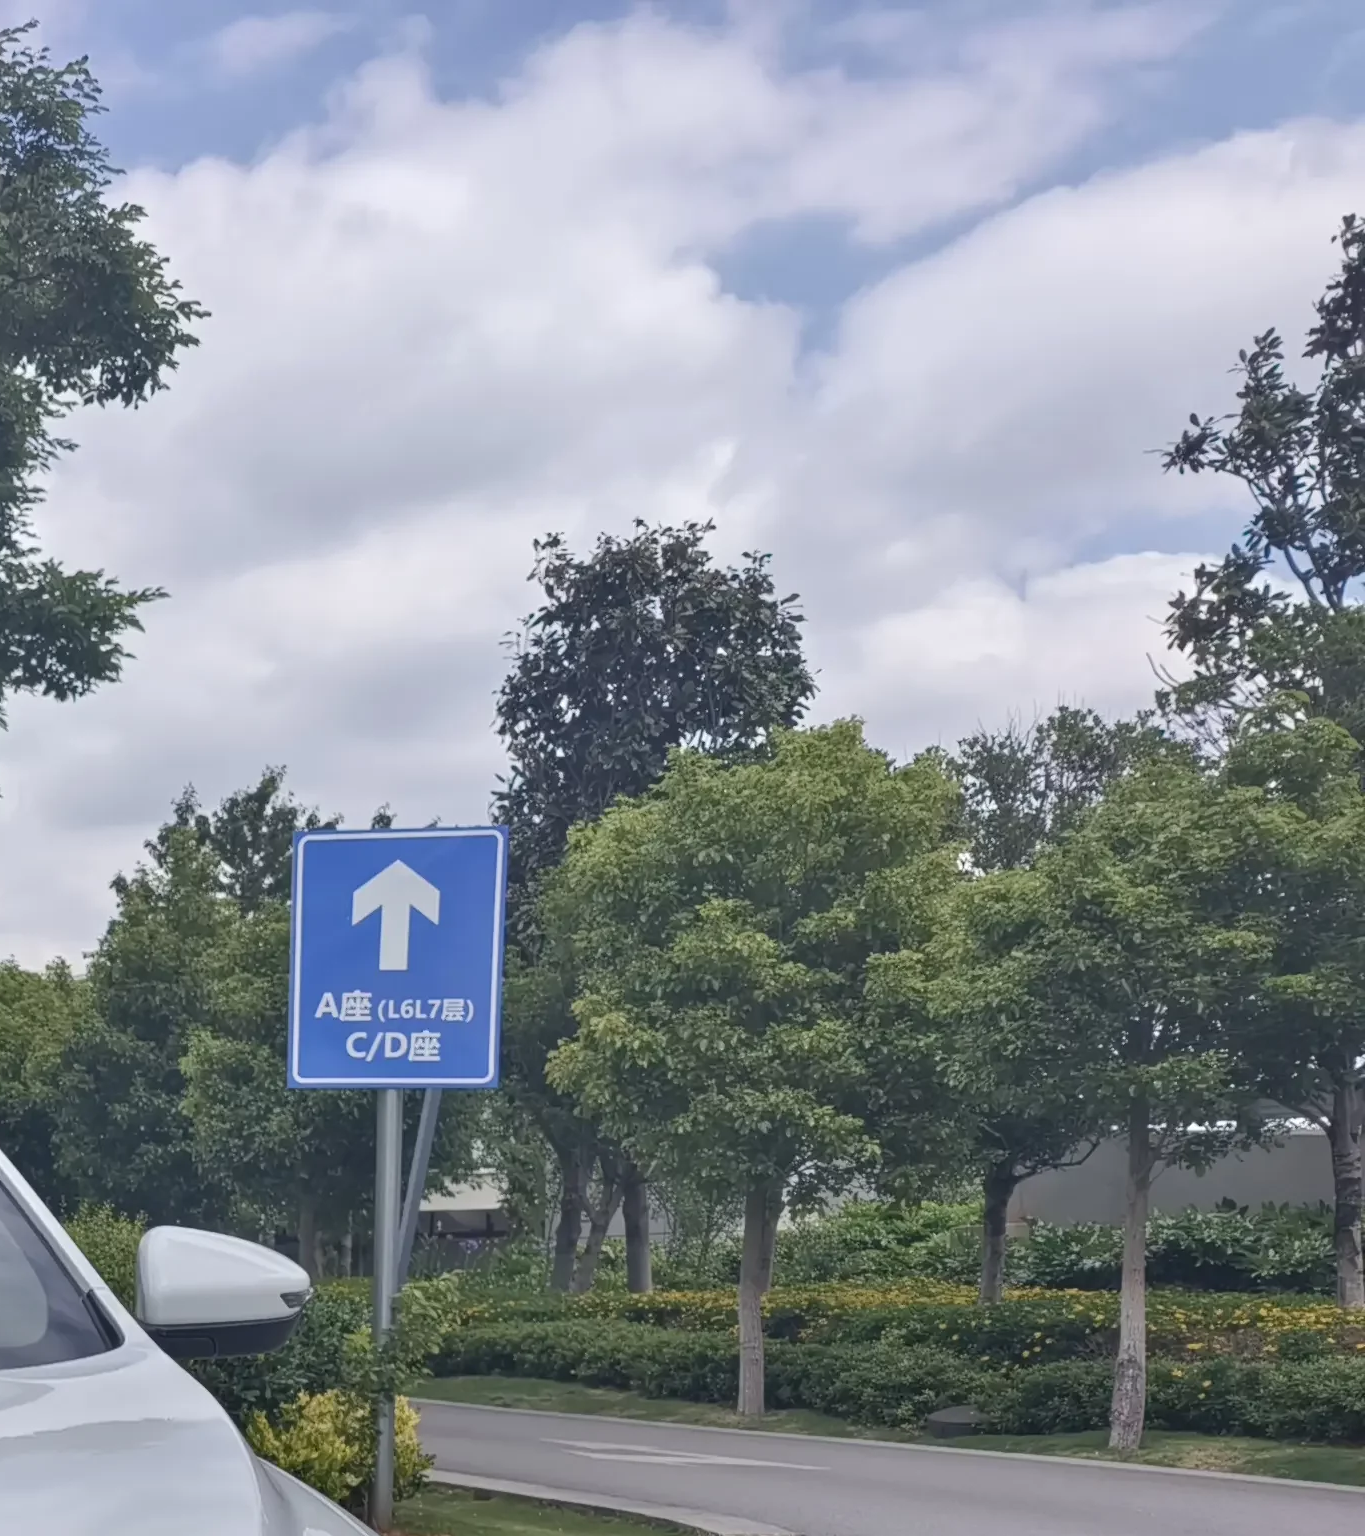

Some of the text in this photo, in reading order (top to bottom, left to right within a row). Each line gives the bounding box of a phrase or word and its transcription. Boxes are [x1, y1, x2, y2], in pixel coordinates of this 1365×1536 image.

[315, 990, 474, 1023] A座 (L6L7层)
[346, 1030, 441, 1062] C/D座
